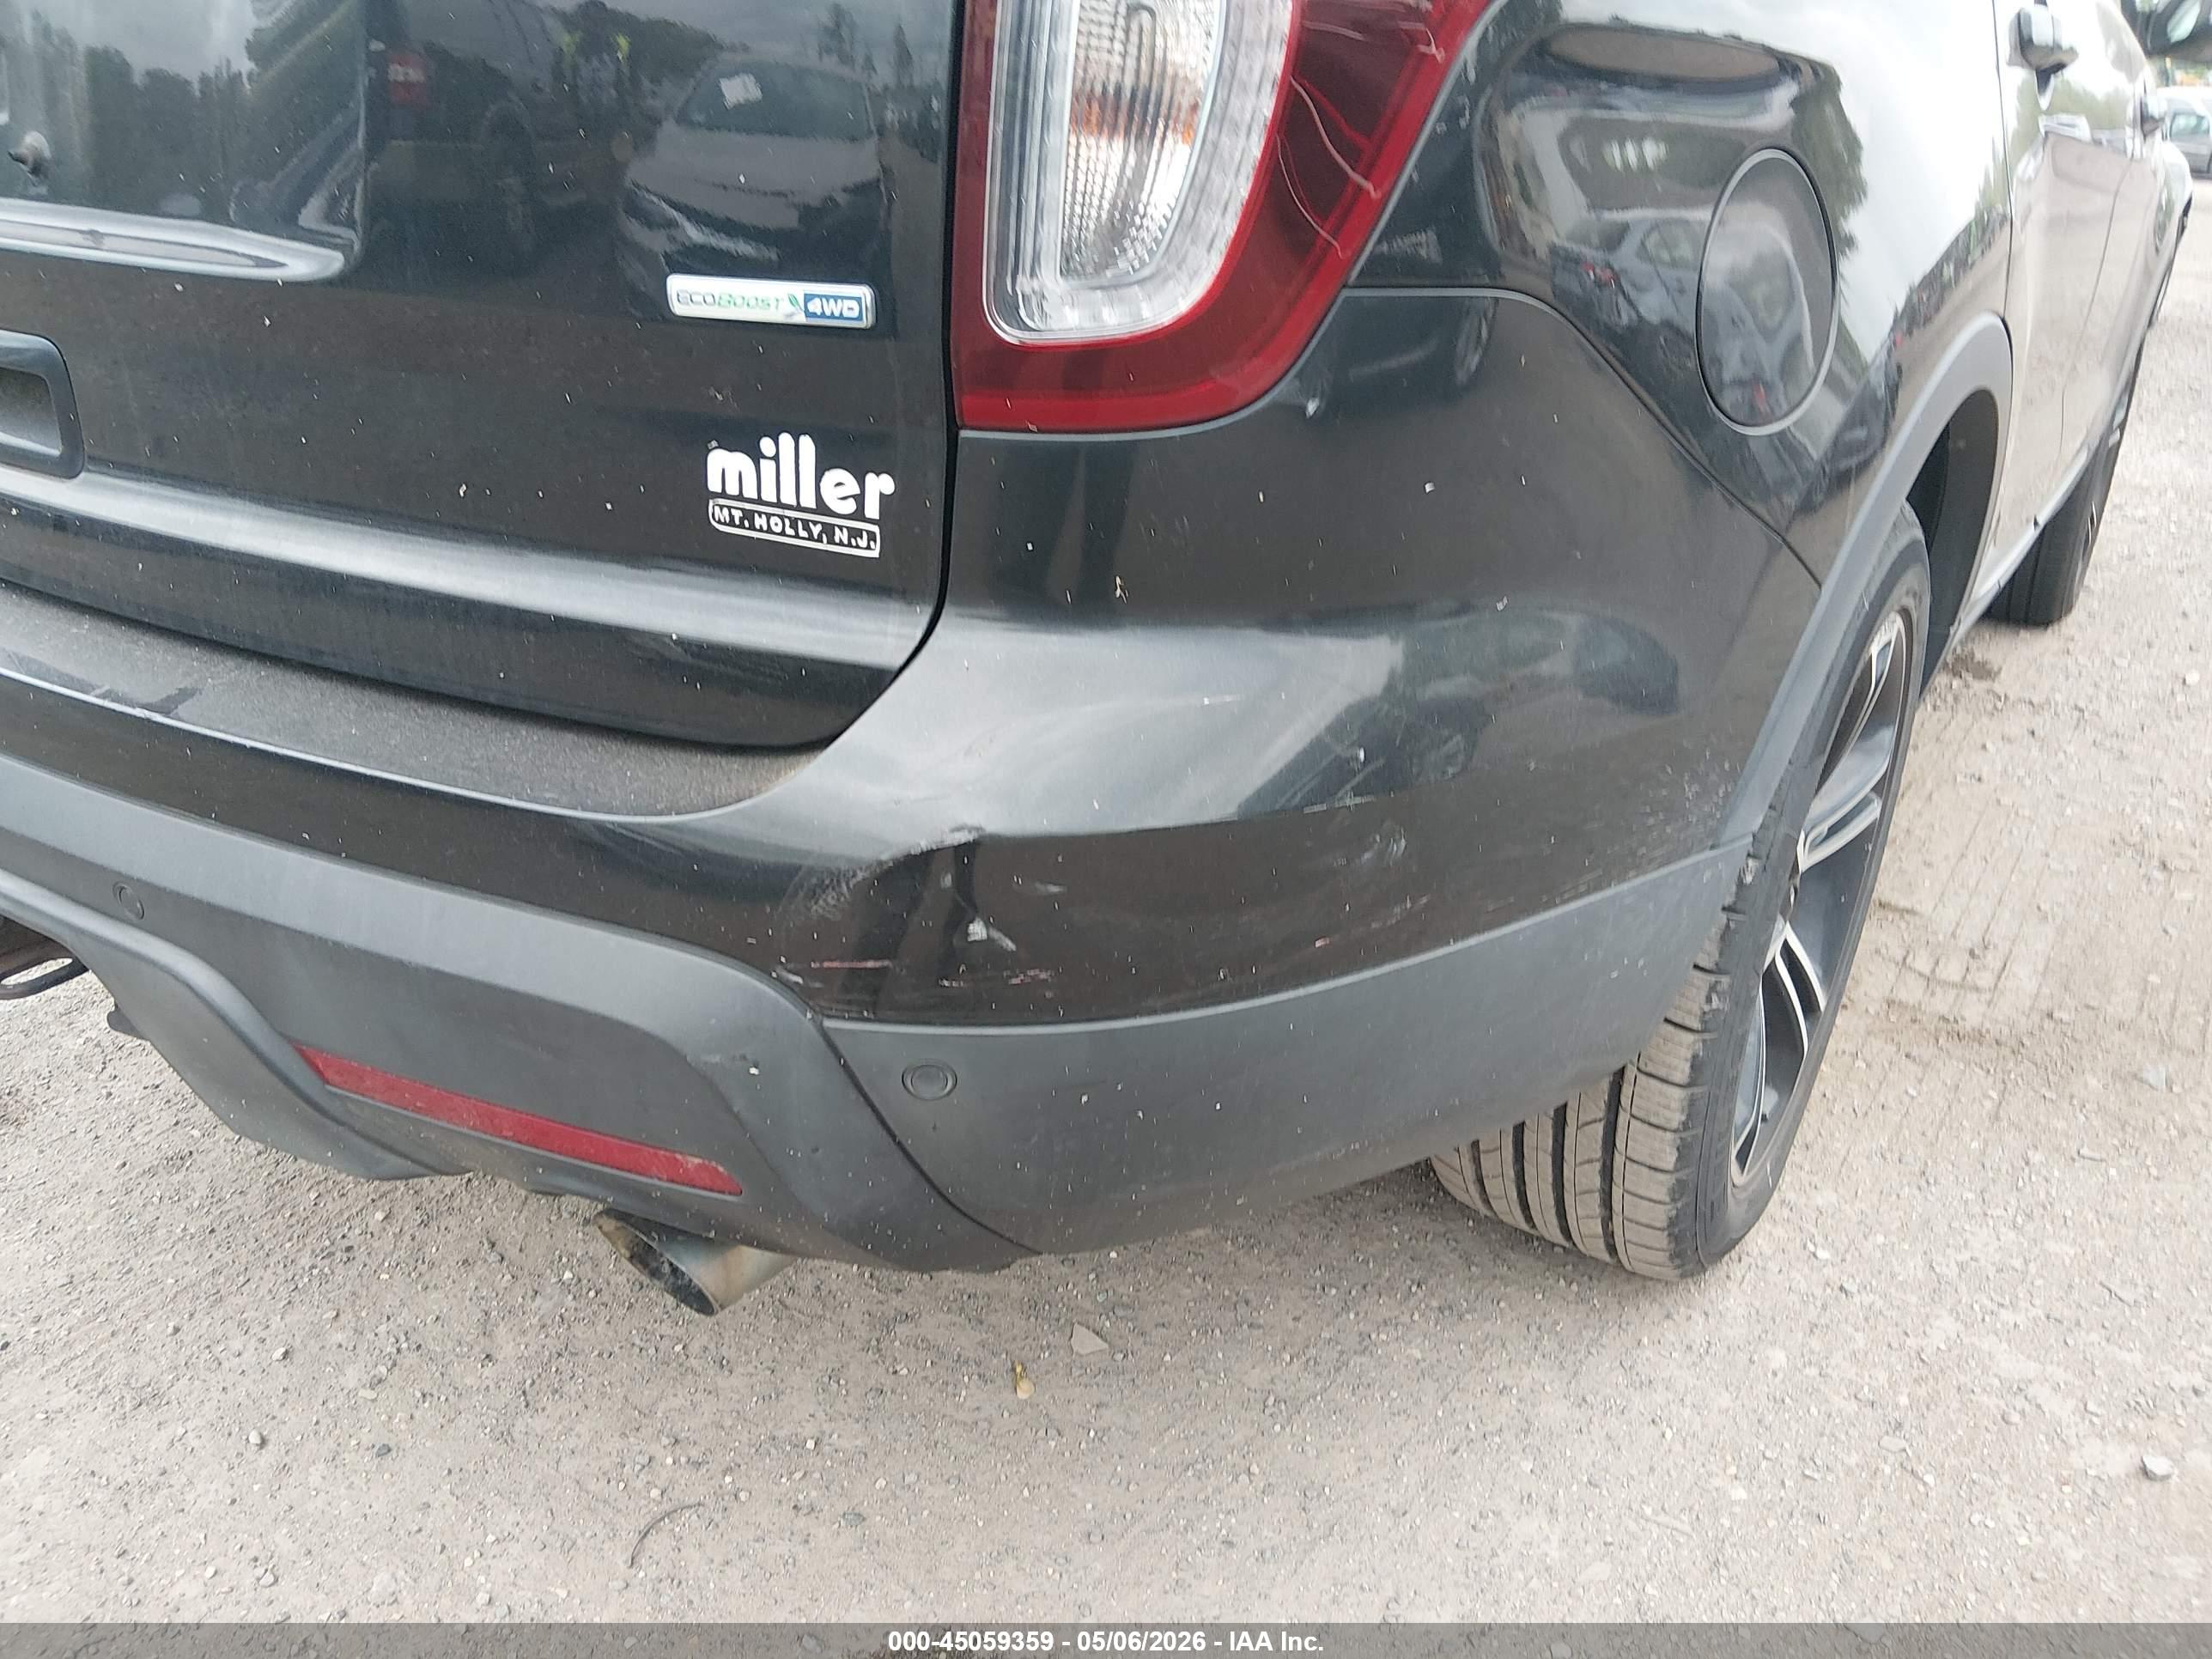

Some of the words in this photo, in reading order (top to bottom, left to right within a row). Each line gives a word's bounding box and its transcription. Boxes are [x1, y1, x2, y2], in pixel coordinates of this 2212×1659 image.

[806, 296, 860, 319] 4WD
[707, 431, 895, 520] miller
[714, 504, 750, 528] MT.
[754, 512, 828, 544] HOLLY,
[833, 526, 876, 550] N.J.
